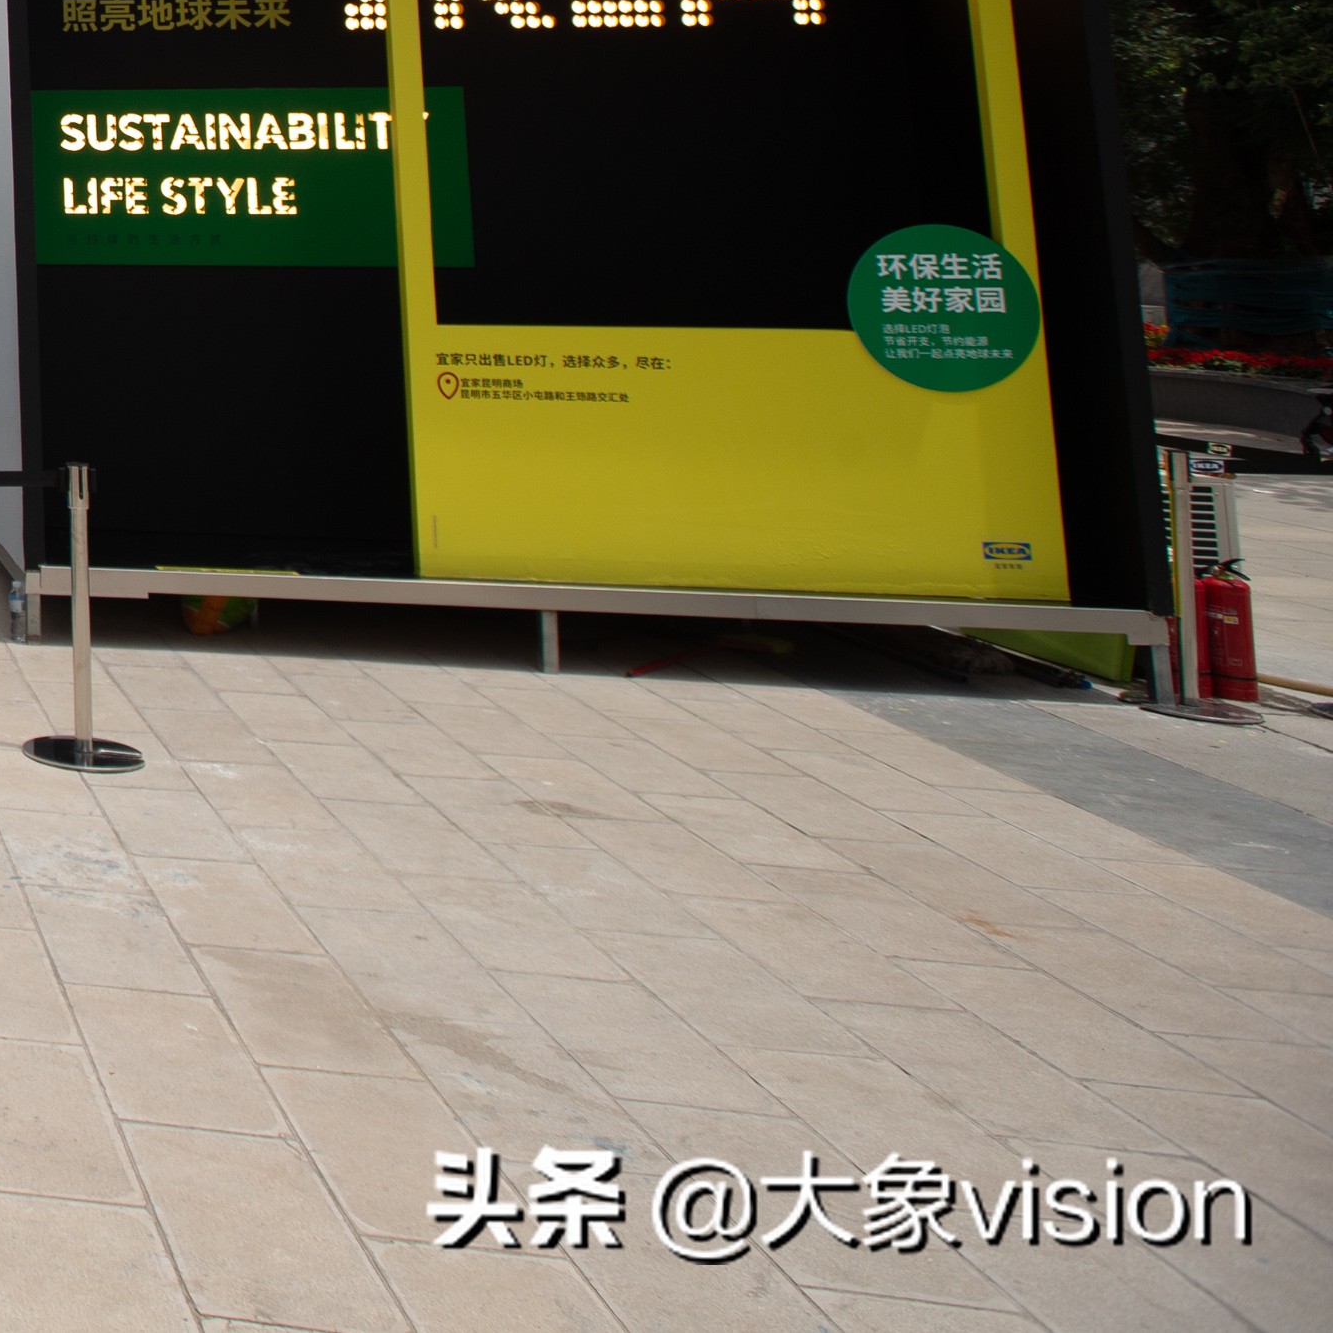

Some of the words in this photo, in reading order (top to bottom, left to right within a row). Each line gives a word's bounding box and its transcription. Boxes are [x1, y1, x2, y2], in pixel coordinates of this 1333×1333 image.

[60, 112, 394, 151] SUSTAINABILIT
[62, 176, 149, 215] LIFE
[161, 176, 298, 216] STYLE
[876, 253, 1003, 280] 环保生活
[881, 286, 1008, 314] 美好家园
[882, 323, 950, 335] 选择LED灯泡
[885, 348, 1014, 360] 让我们一起点亮地球未来
[460, 378, 524, 389] 宜家昆明商场
[988, 547, 1028, 555] IKEA
